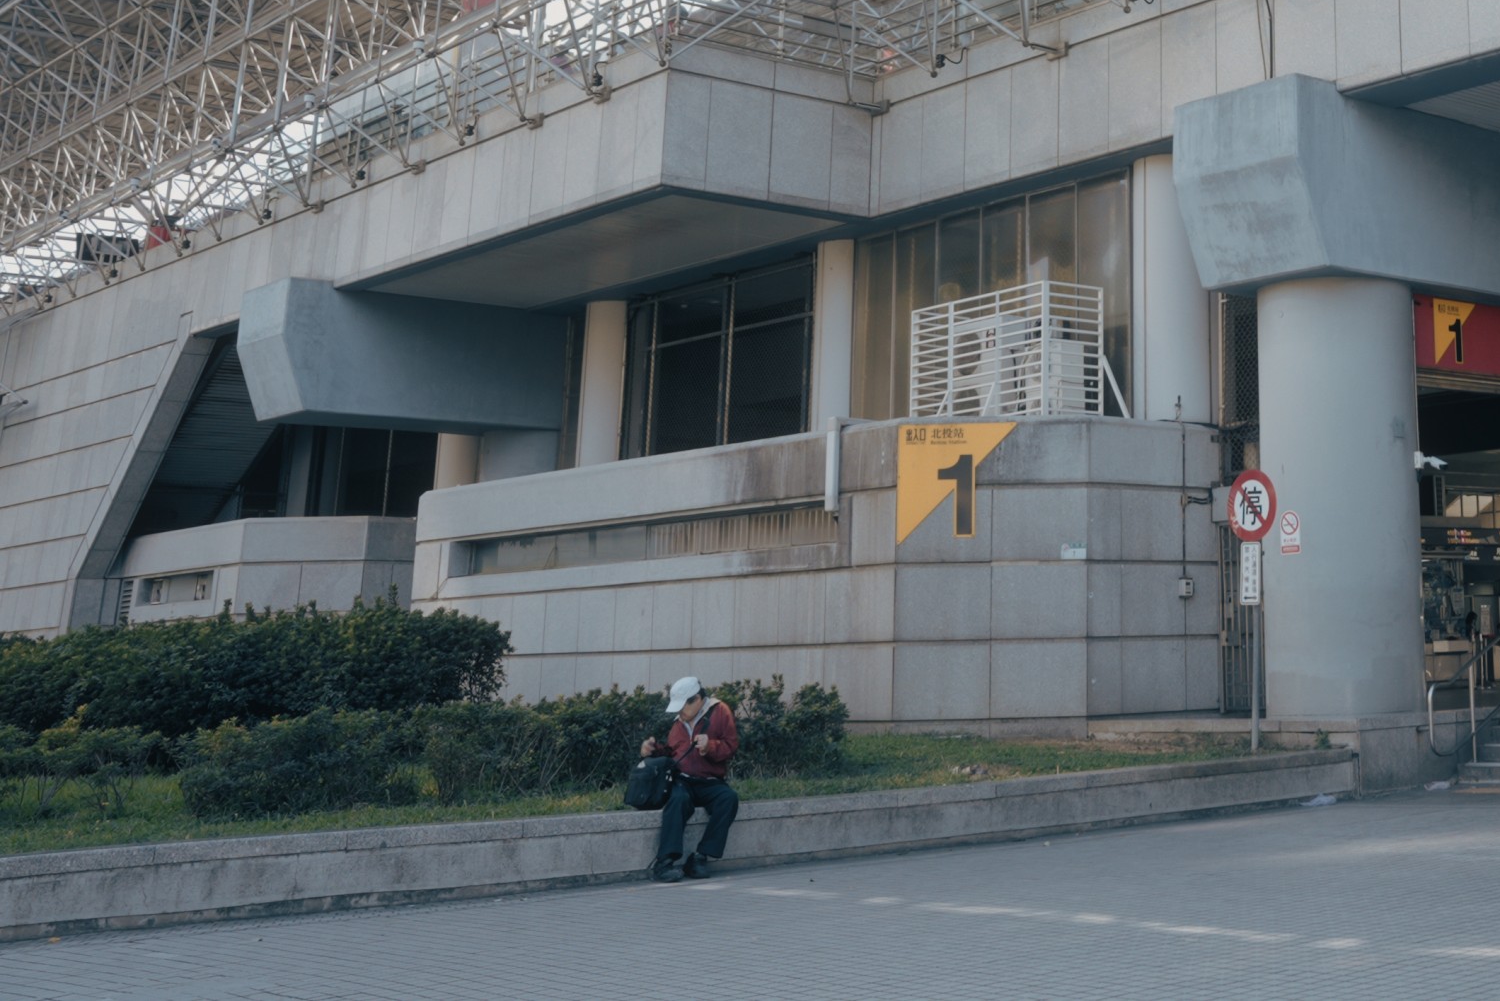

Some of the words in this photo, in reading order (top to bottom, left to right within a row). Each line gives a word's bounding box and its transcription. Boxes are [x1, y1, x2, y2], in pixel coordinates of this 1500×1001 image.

[1449, 318, 1462, 363] 1
[906, 428, 926, 441] 出入口
[931, 428, 964, 438] 北投站
[938, 454, 972, 535] 1
[1240, 486, 1262, 525] 停
